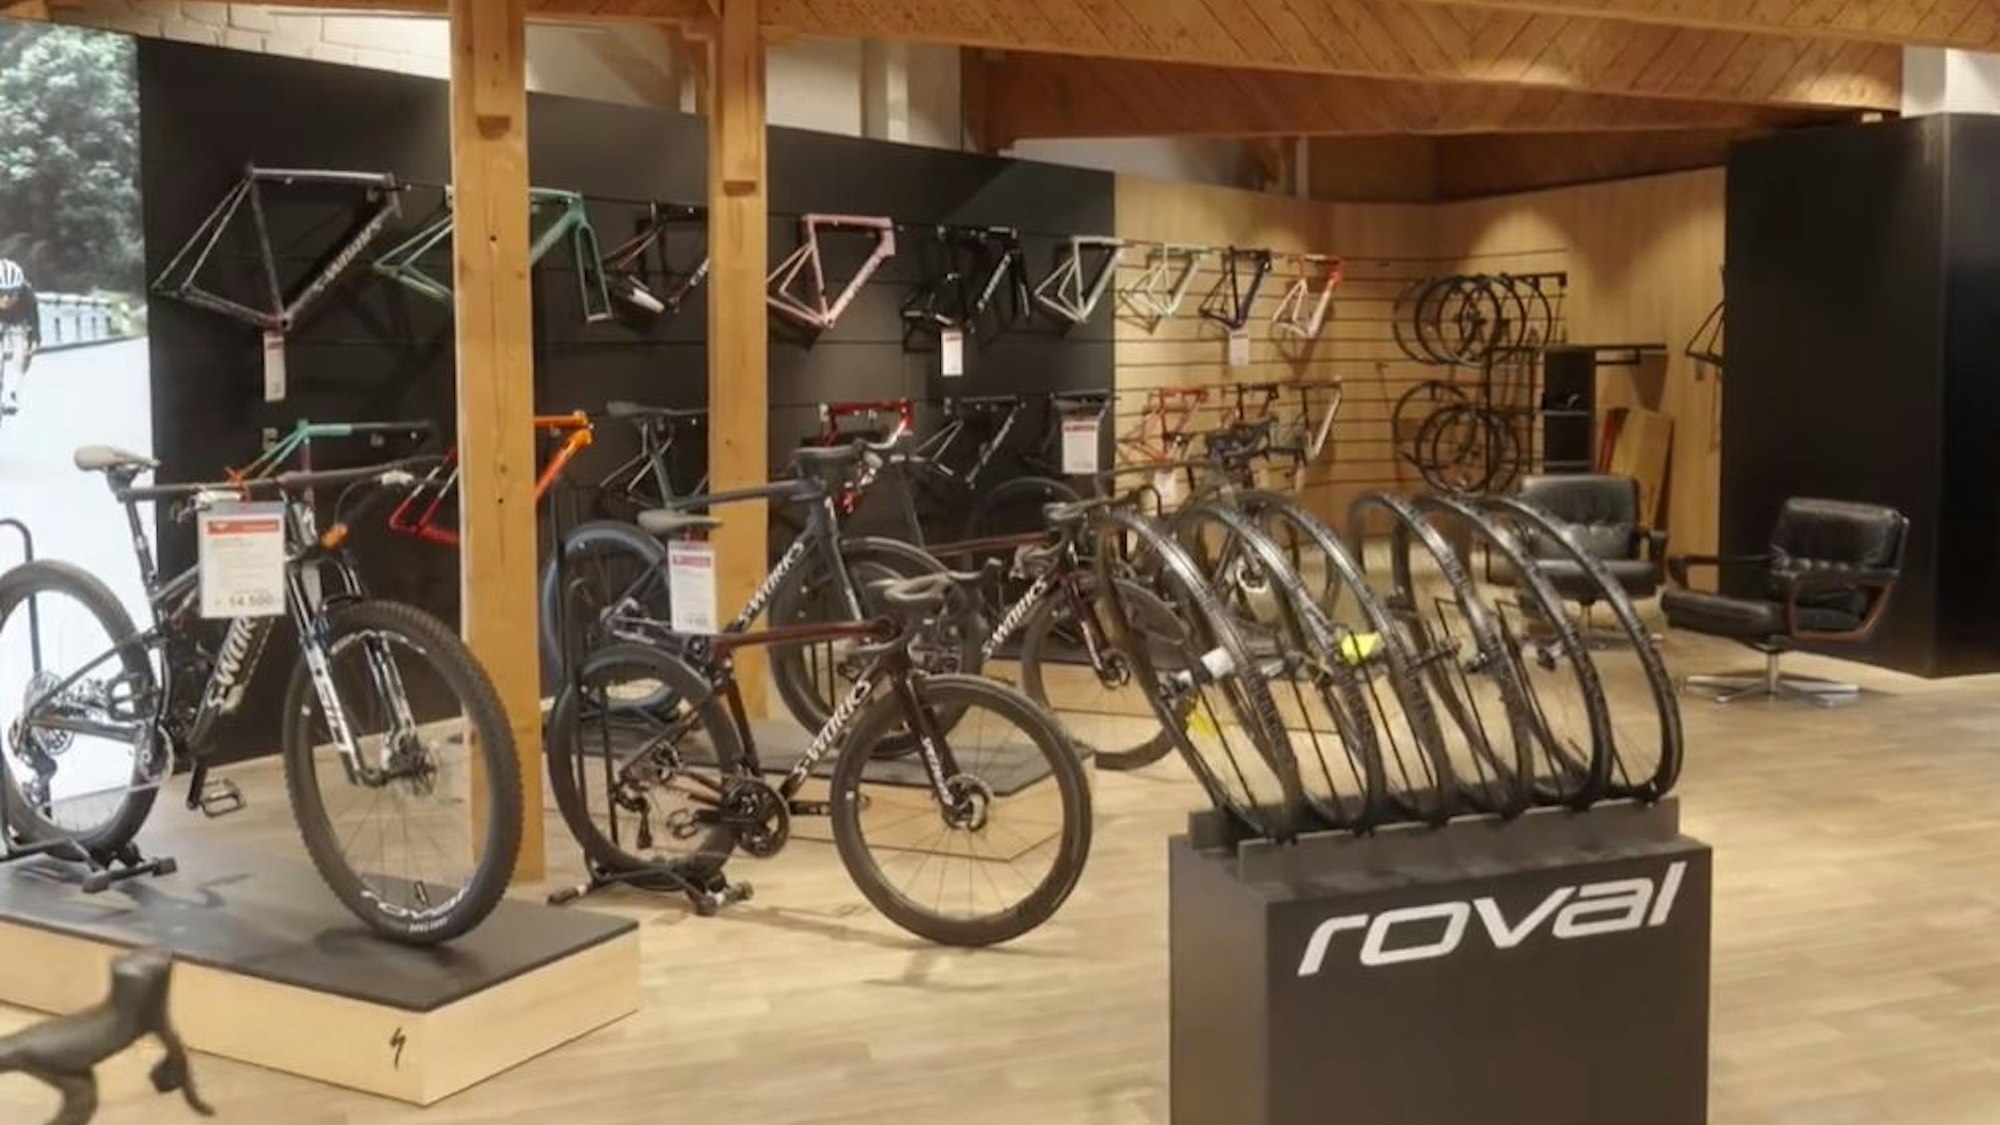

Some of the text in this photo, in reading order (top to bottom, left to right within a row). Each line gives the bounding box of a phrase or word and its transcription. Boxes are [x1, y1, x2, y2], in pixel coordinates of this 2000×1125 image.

[737, 542, 805, 629] S-WORKS
[982, 577, 1048, 660] S-WORKS
[206, 617, 257, 708] S-WOR
[794, 681, 872, 783] S-WORKS
[1298, 861, 1687, 976] roval
